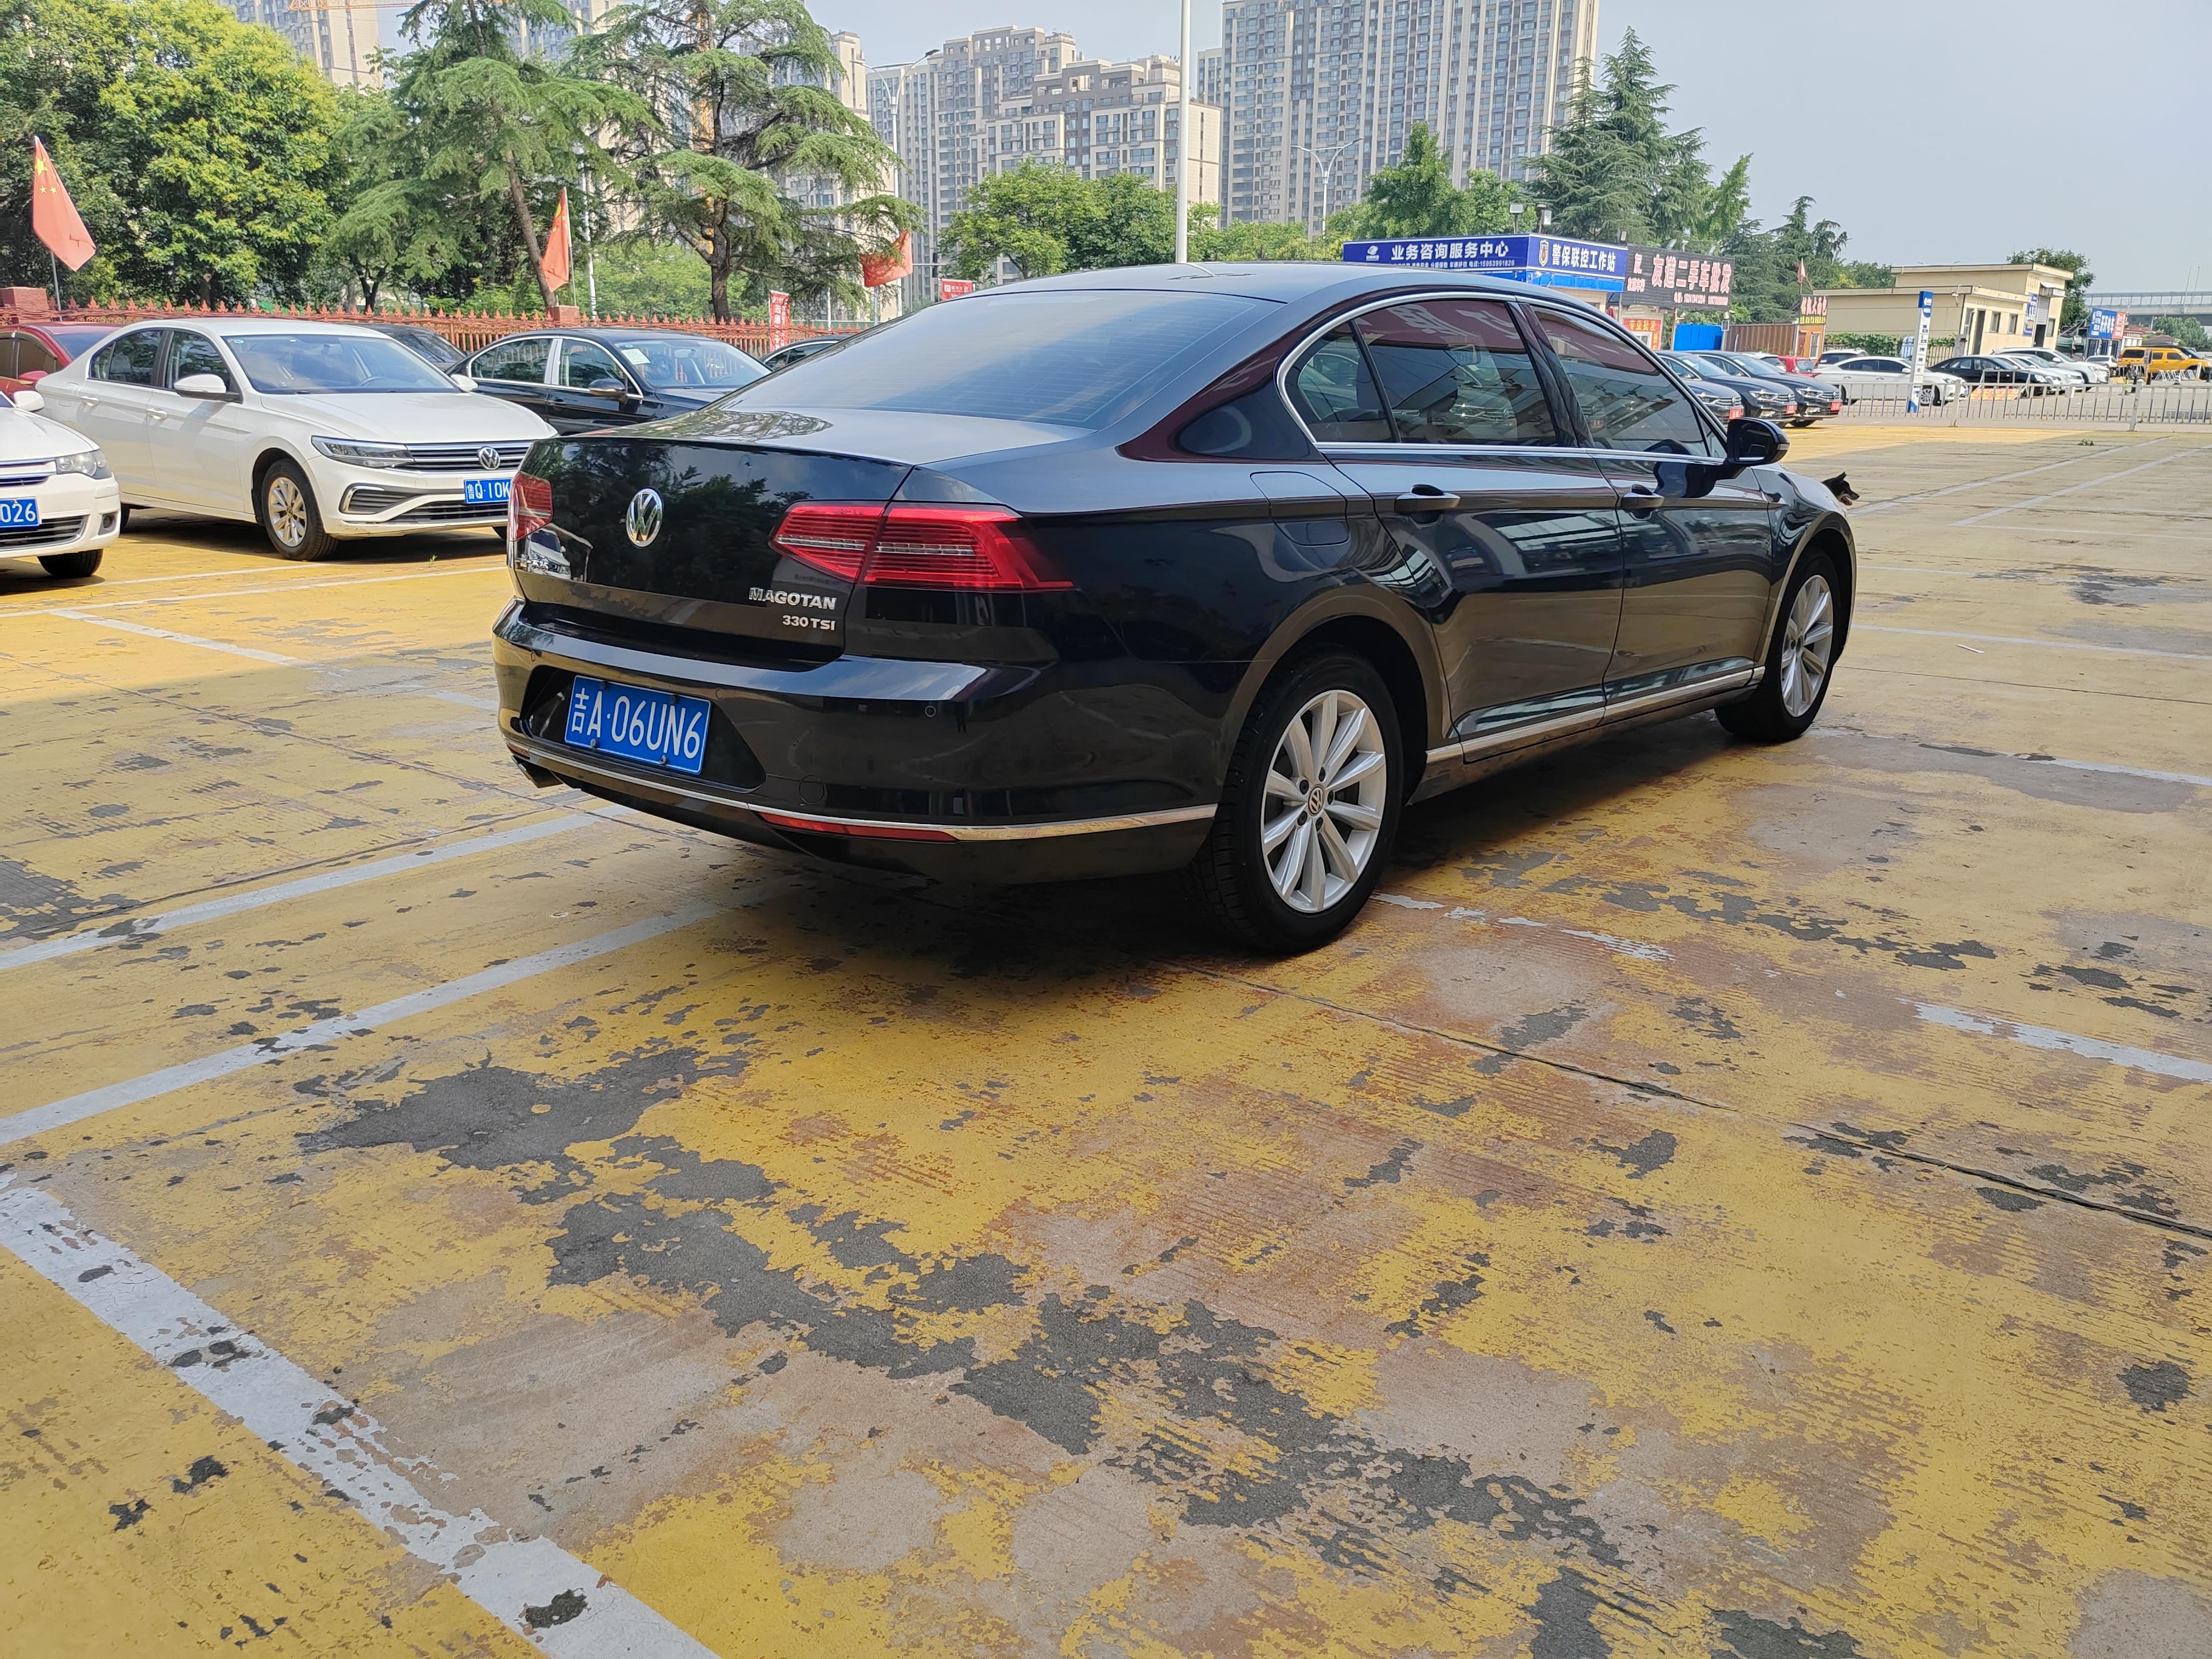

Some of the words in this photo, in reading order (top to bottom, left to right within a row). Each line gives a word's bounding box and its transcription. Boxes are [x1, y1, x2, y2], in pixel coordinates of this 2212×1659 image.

[1391, 241, 1509, 261] 业务咨询服务中心
[1552, 243, 1616, 272] 警保联控工作站
[1652, 253, 1732, 294] 友道二手车批发
[1, 503, 36, 523] 026
[748, 587, 837, 610] MAGOTAN
